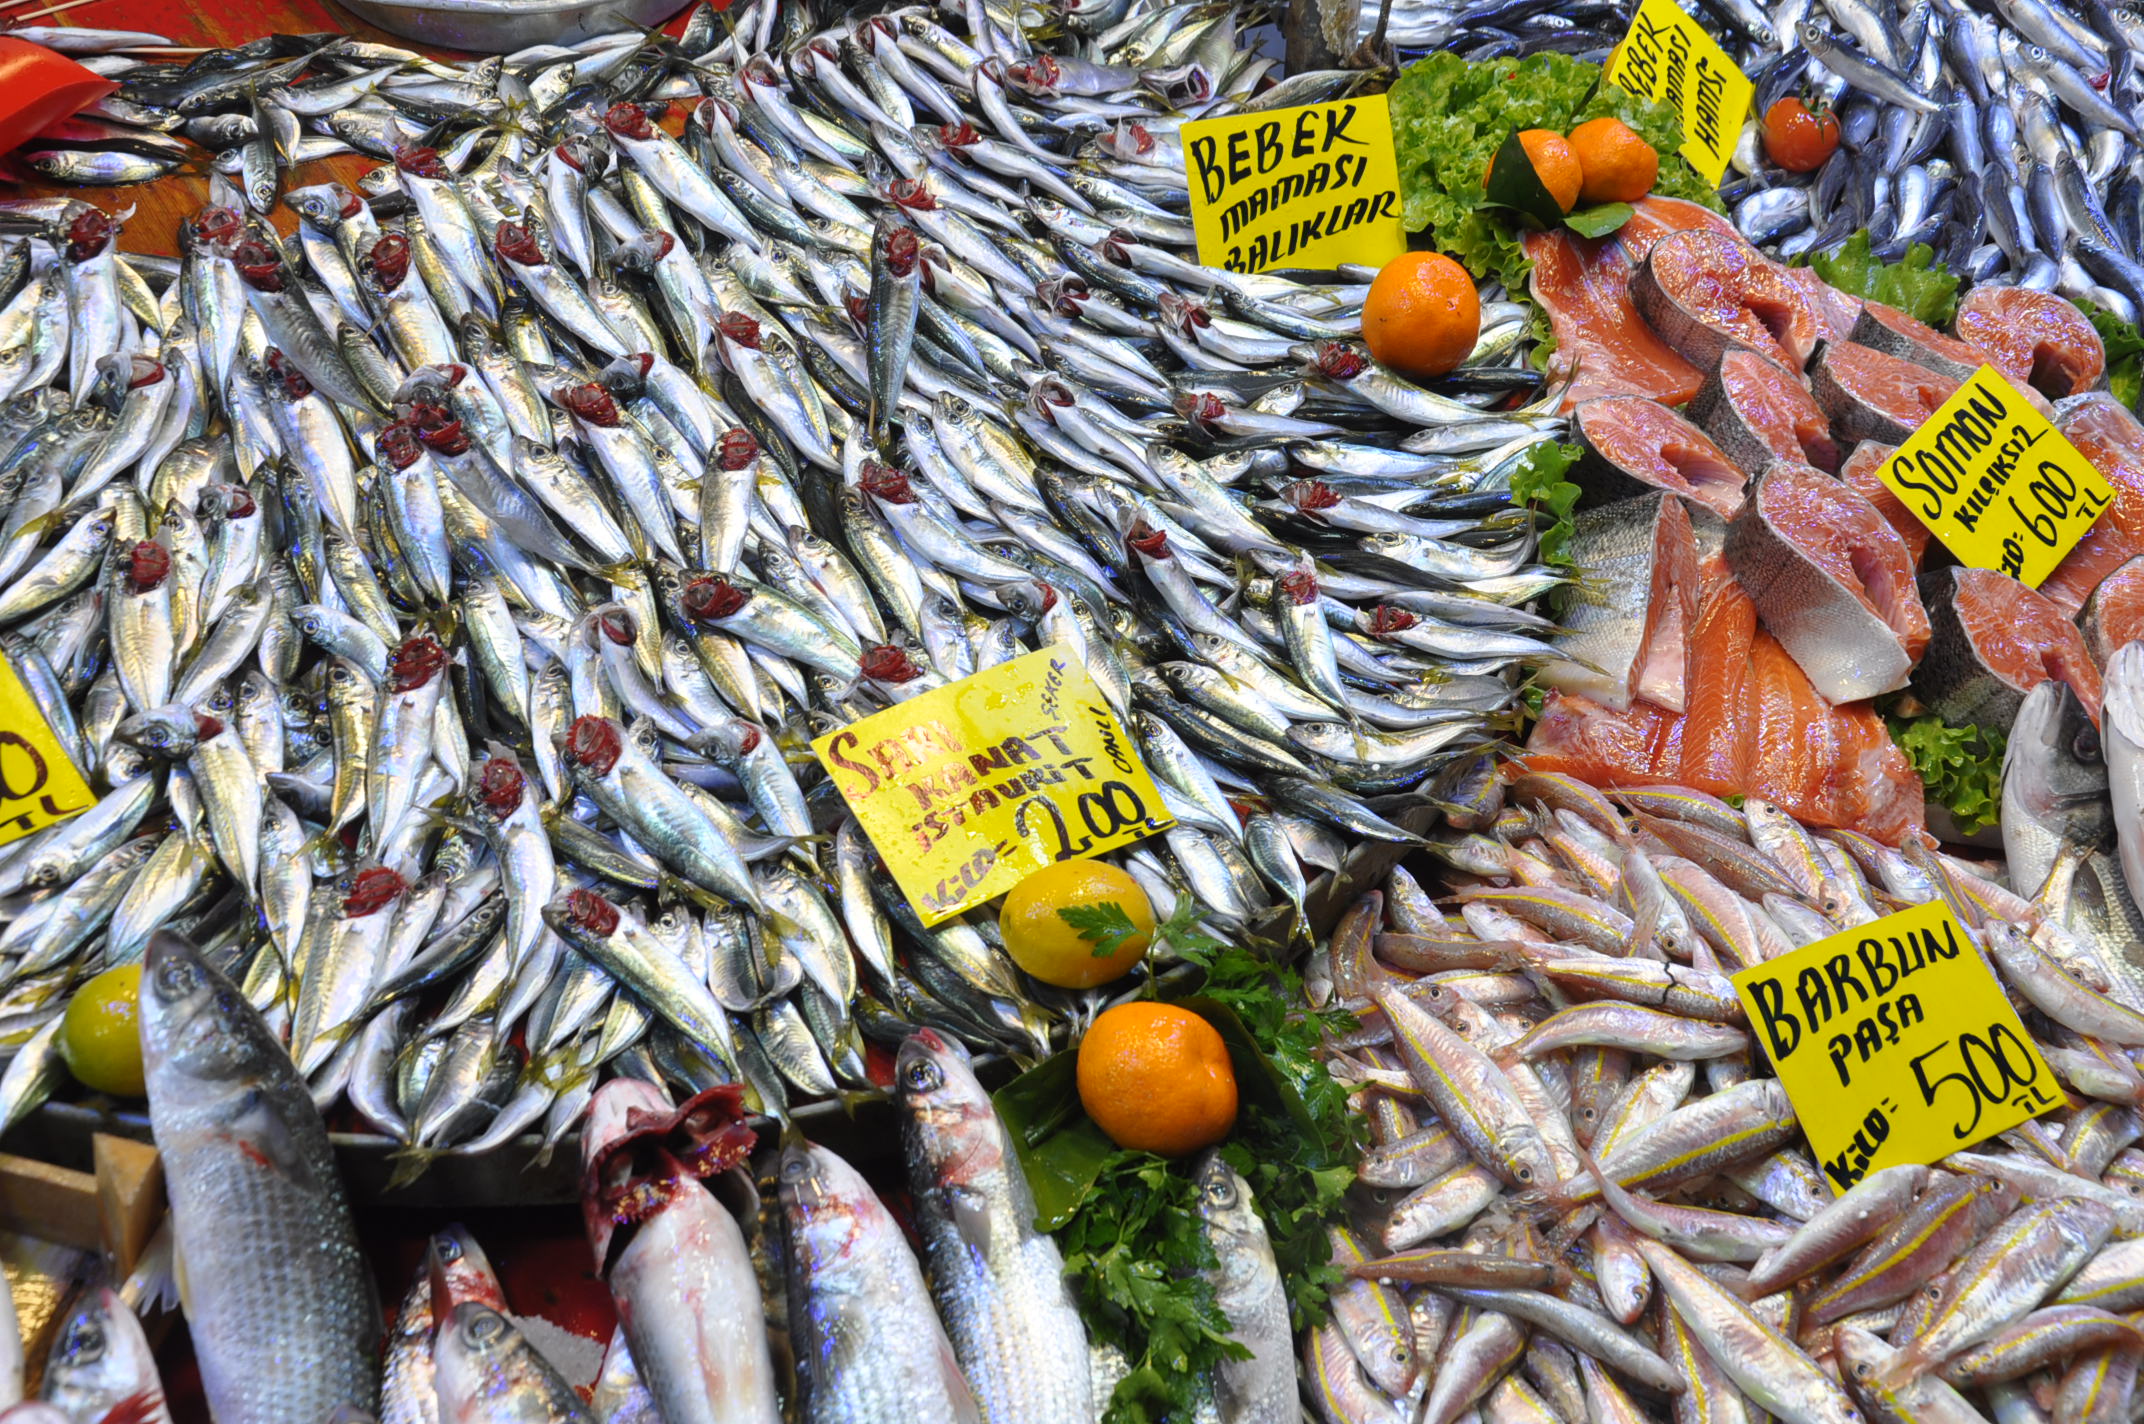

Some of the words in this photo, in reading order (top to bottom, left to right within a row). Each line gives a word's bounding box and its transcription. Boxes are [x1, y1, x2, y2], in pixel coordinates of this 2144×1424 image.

[1190, 104, 1370, 206] BEBEK
[1220, 154, 1367, 244] MAMASI
[1224, 191, 1400, 274] BALIKLAR
[1892, 382, 2007, 520] SOMON
[2075, 488, 2111, 518] TL
[905, 726, 1072, 811] KANAT
[1746, 920, 1960, 1061] BARBUN
[1828, 993, 1924, 1088] PAŞA
[1910, 1022, 2037, 1139] 500
[2011, 1086, 2056, 1114] TL
